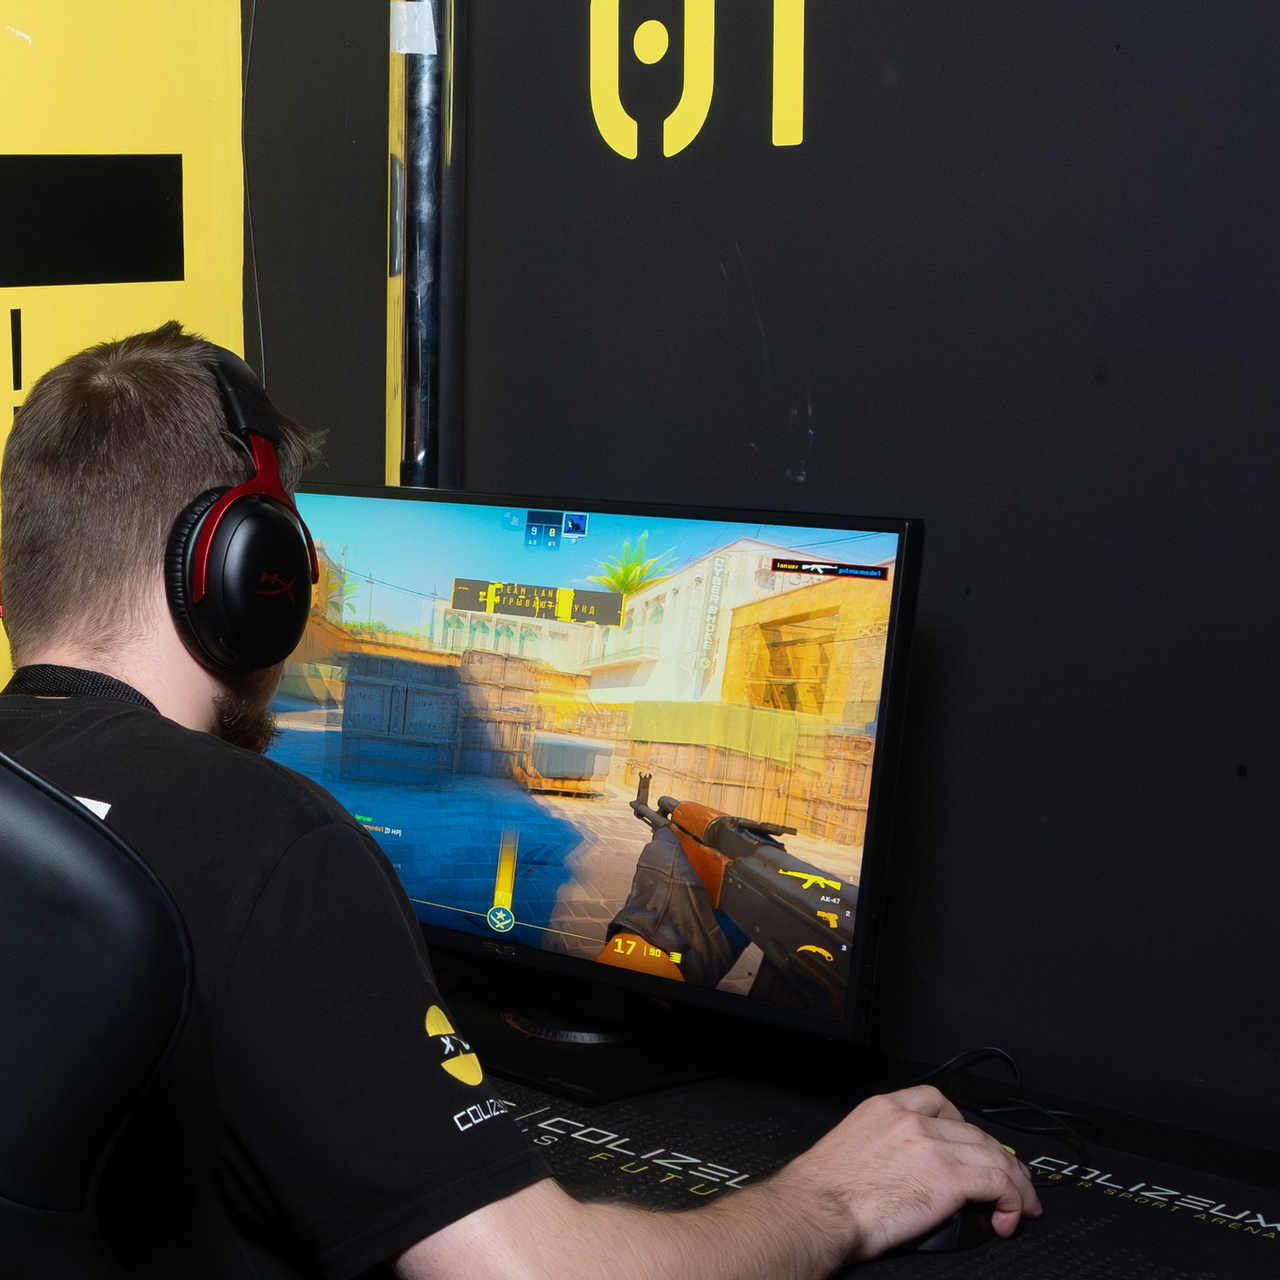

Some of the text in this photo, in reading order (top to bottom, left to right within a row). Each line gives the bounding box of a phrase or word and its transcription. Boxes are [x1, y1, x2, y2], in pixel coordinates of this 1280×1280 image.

[820, 895, 841, 905] AK-47
[613, 938, 661, 958] 17 90
[1104, 1188, 1181, 1212] SPORT
[1194, 1213, 1276, 1239] ARENA
